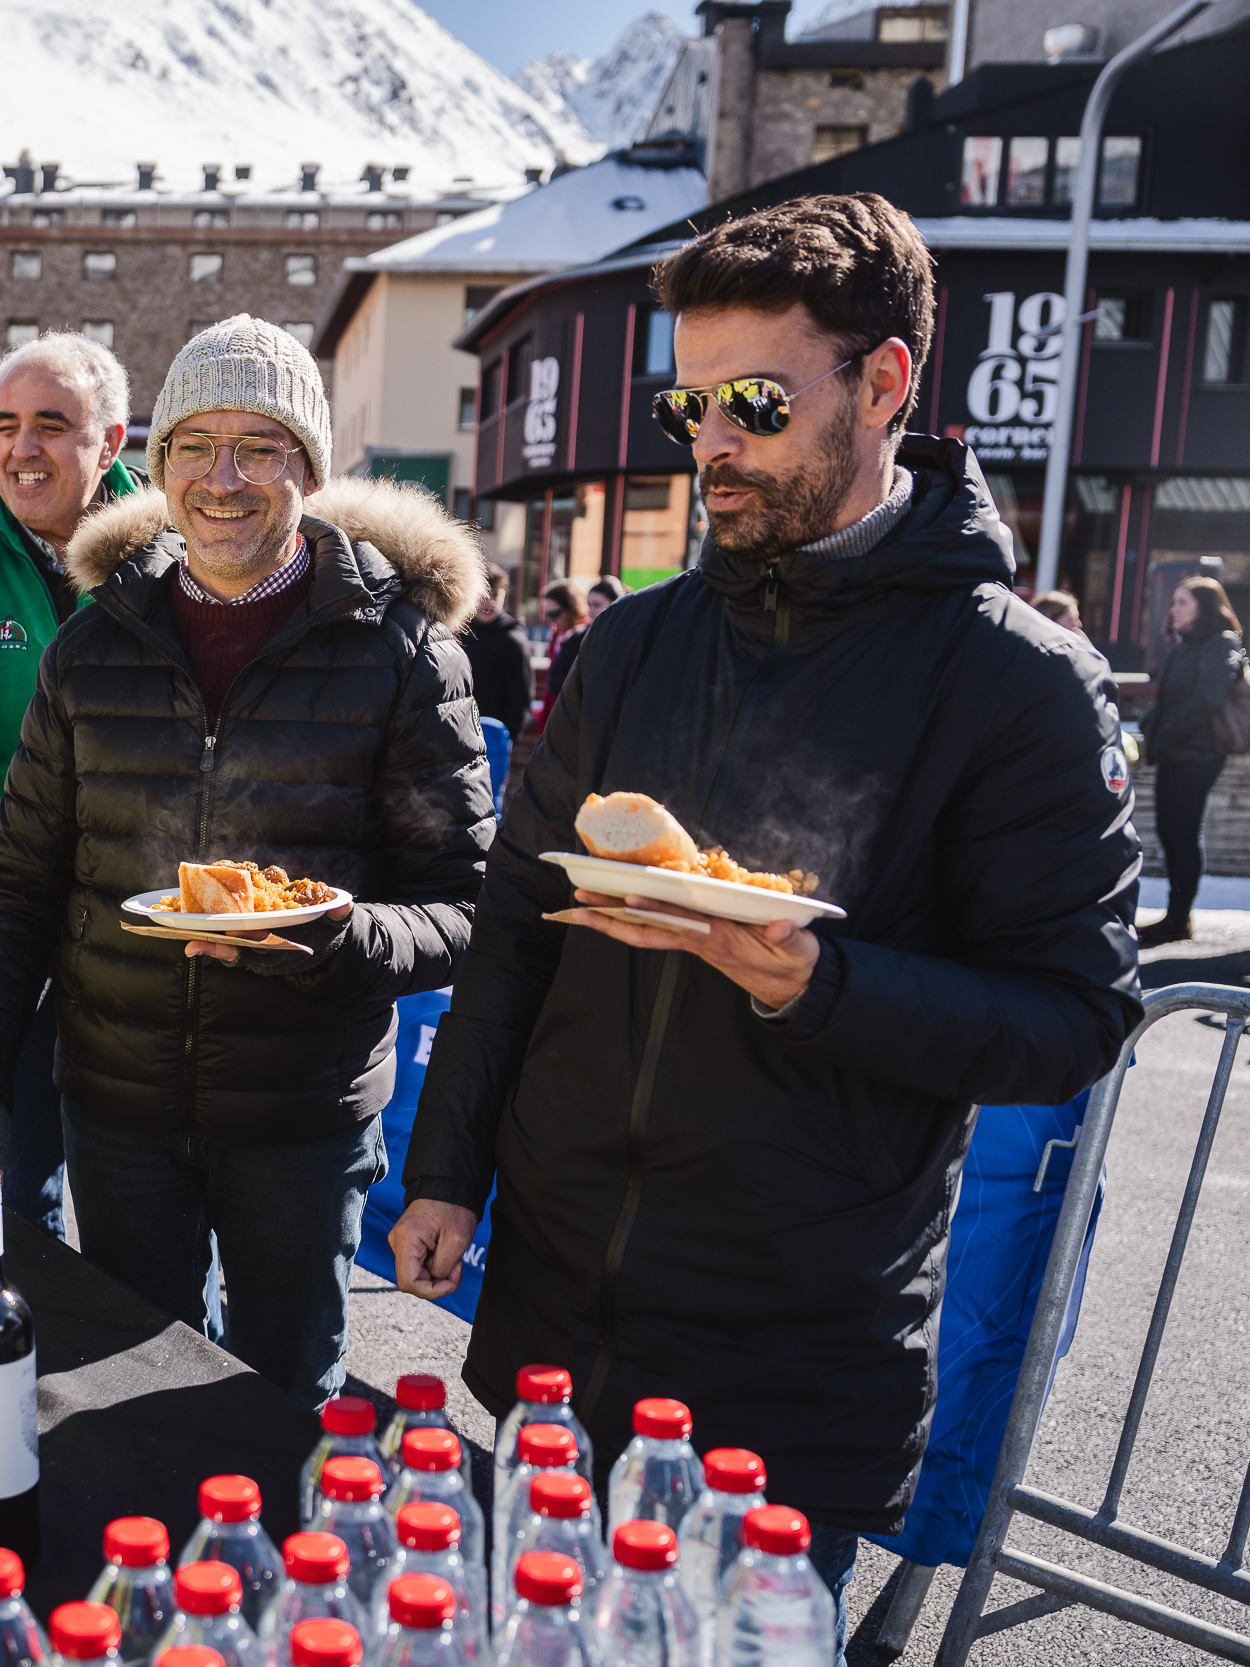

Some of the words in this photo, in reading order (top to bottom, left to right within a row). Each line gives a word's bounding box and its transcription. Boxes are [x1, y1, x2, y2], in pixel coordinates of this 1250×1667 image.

[979, 291, 1068, 361] 19
[530, 357, 560, 401] 19
[966, 356, 1059, 424] 65
[524, 398, 558, 444] 65
